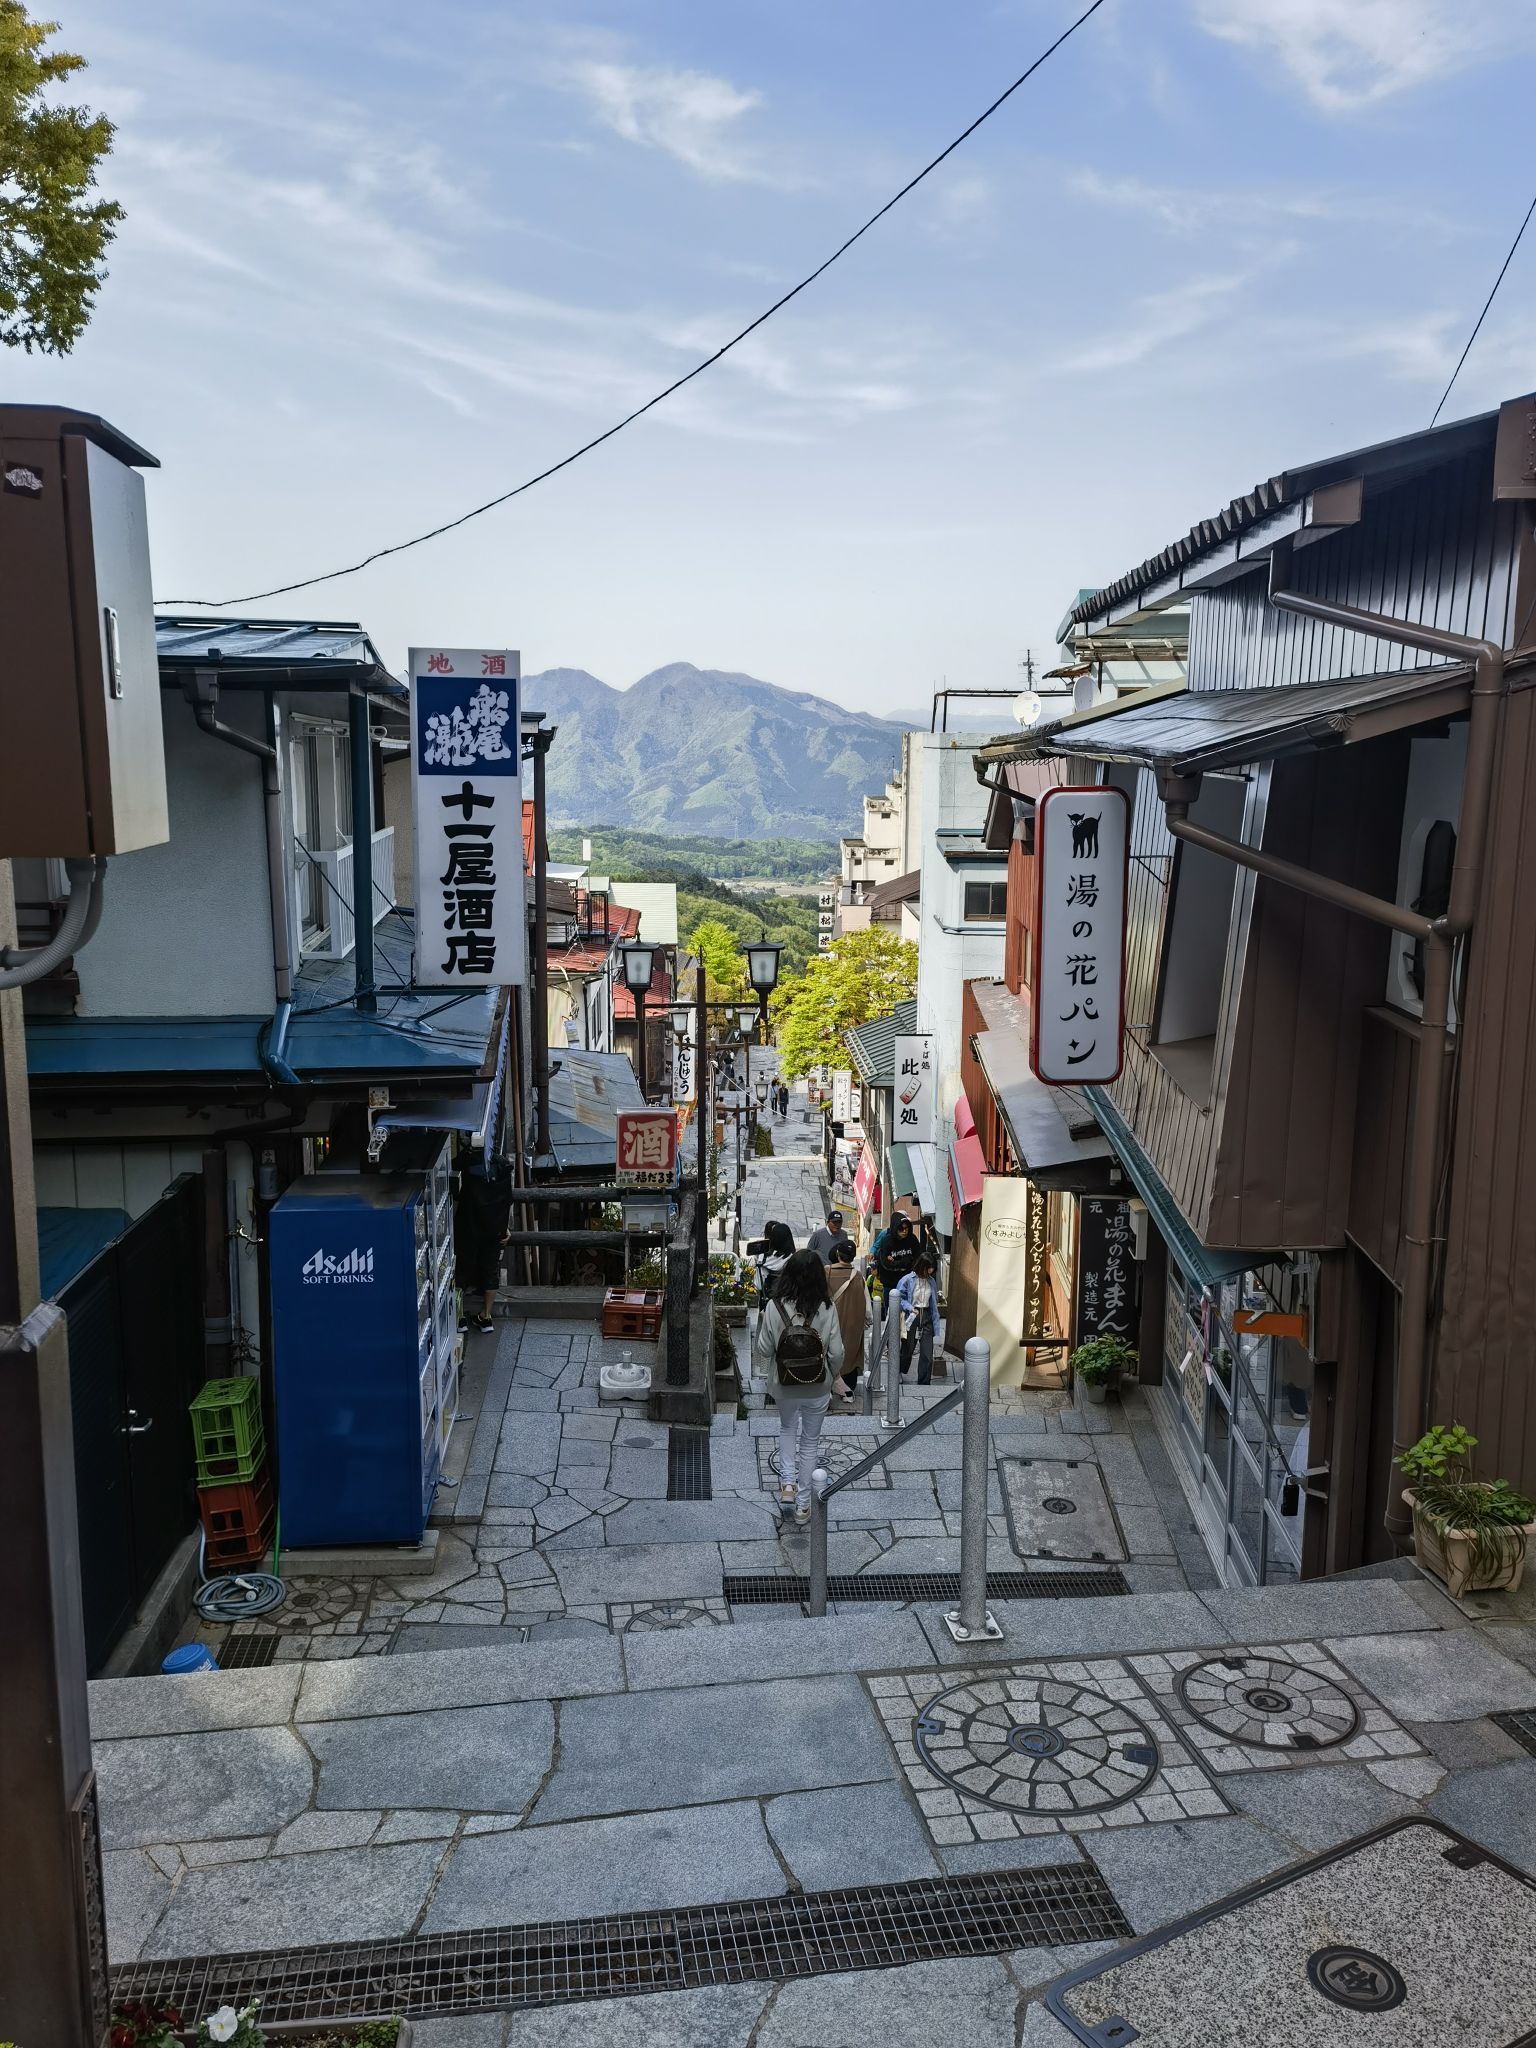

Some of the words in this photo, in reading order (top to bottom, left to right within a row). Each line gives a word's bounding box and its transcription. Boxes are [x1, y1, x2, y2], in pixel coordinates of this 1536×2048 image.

[440, 780, 497, 976] 十一屋酒店
[820, 894, 832, 960] 村松旅
[1059, 873, 1101, 1065] 湯の花パン
[921, 1040, 931, 1070] そば処
[623, 1118, 672, 1166] 酒
[635, 1171, 675, 1184] 福だるま
[302, 1247, 375, 1275] Asahi
[303, 1275, 331, 1285] SOFT
[333, 1274, 375, 1284] DRINKS
[1085, 1271, 1100, 1322] 製造元
